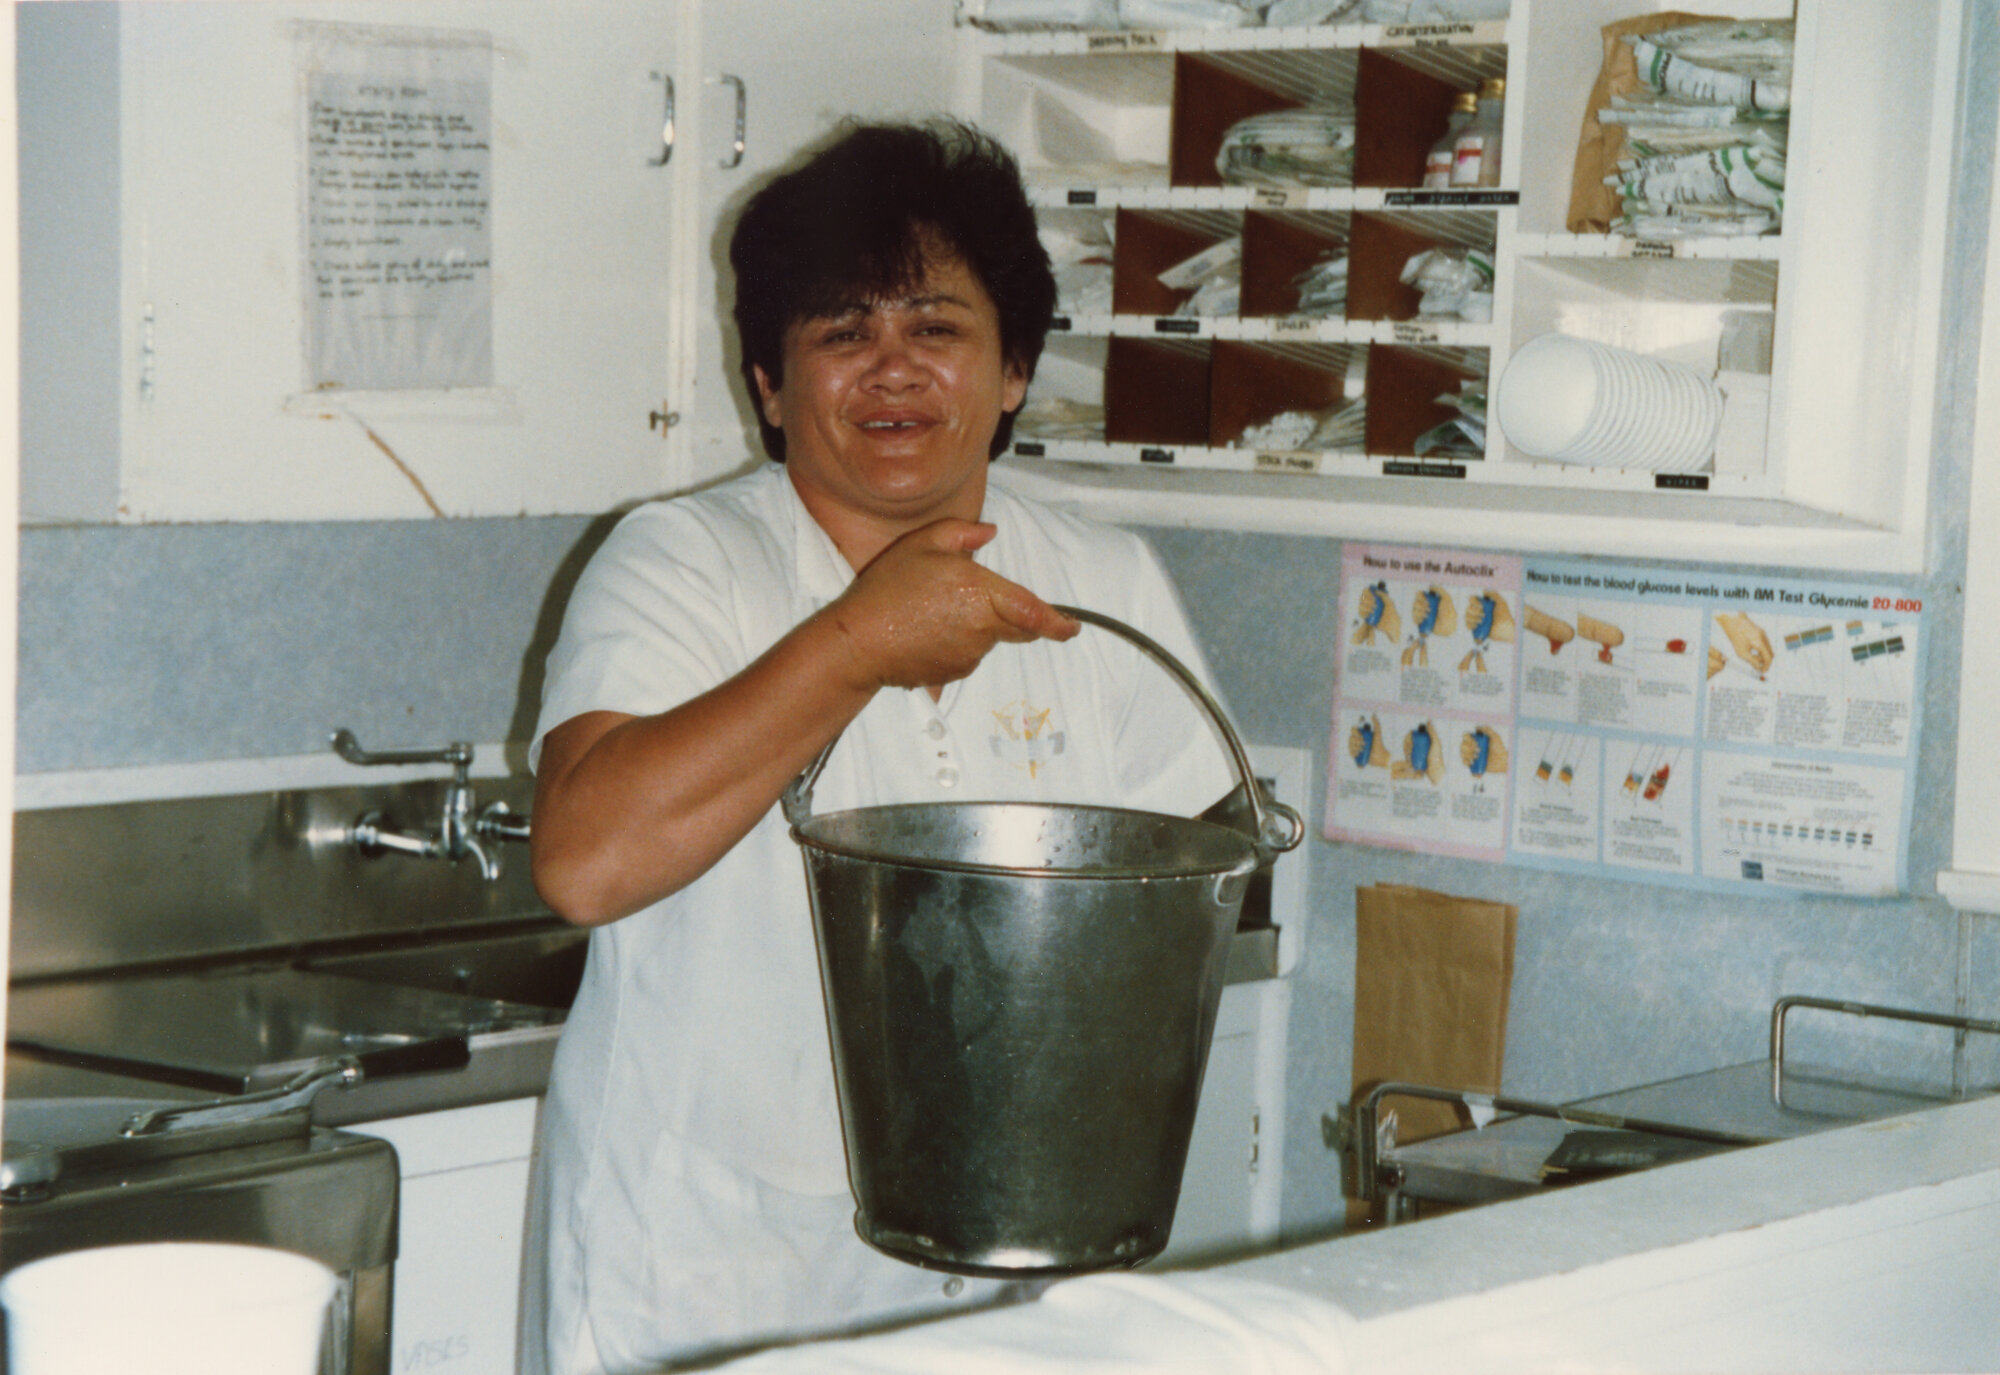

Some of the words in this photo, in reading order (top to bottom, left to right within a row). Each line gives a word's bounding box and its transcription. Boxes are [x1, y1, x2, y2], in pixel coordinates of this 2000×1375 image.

[1364, 554, 1387, 569] How
[1390, 557, 1401, 570] to
[1402, 560, 1422, 572] use
[1424, 559, 1442, 573] the
[1527, 569, 1549, 584] How
[1551, 573, 1561, 585] to
[1563, 574, 1582, 587] test
[1584, 575, 1601, 588] the
[1603, 576, 1636, 592] blood
[1638, 578, 1682, 596] glucose
[1685, 582, 1719, 598] levels
[1722, 586, 1750, 600] with
[1778, 590, 1804, 604] Test
